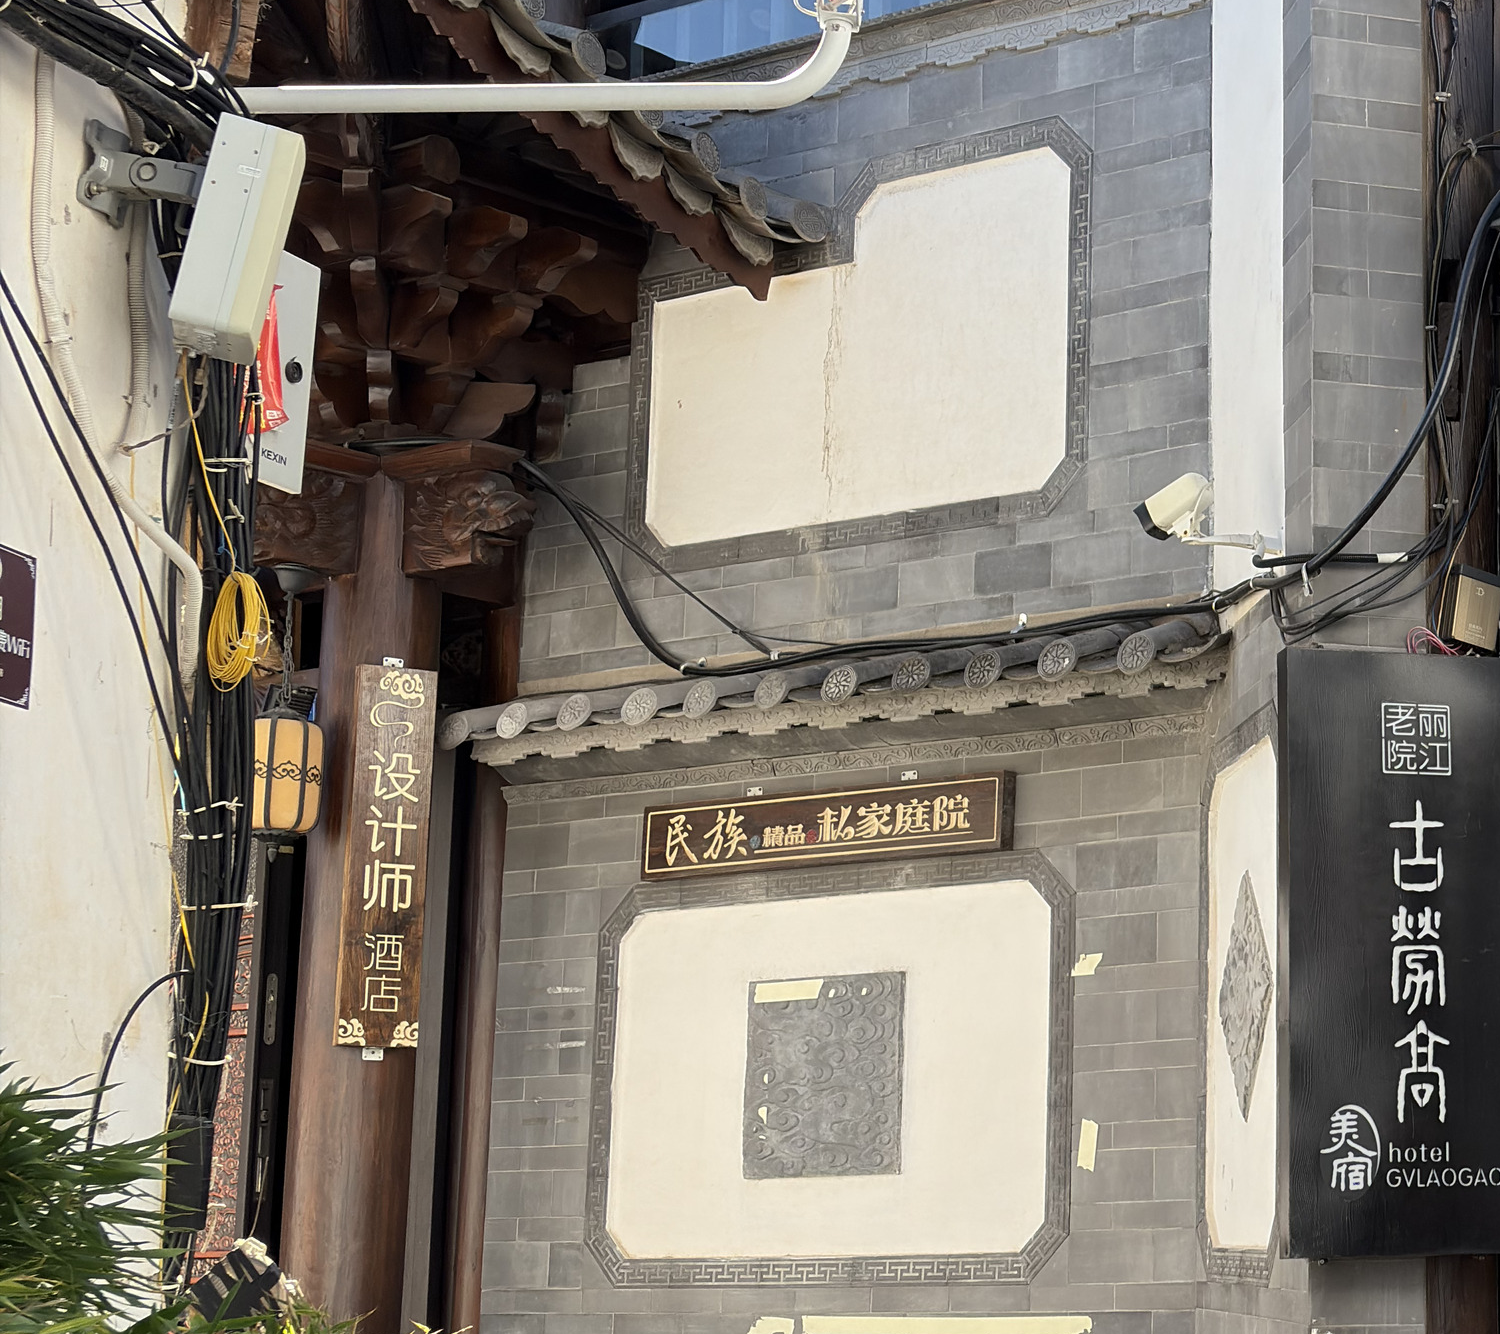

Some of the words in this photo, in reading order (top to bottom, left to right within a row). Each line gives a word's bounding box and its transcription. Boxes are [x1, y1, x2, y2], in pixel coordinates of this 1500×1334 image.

[261, 447, 287, 466] KEXIN
[362, 750, 421, 914] 设计师
[665, 808, 748, 867] 民族
[761, 823, 806, 848] 精品
[815, 793, 971, 843] 私家庭院
[360, 932, 404, 1014] 酒店
[1388, 1141, 1450, 1163] hotel
